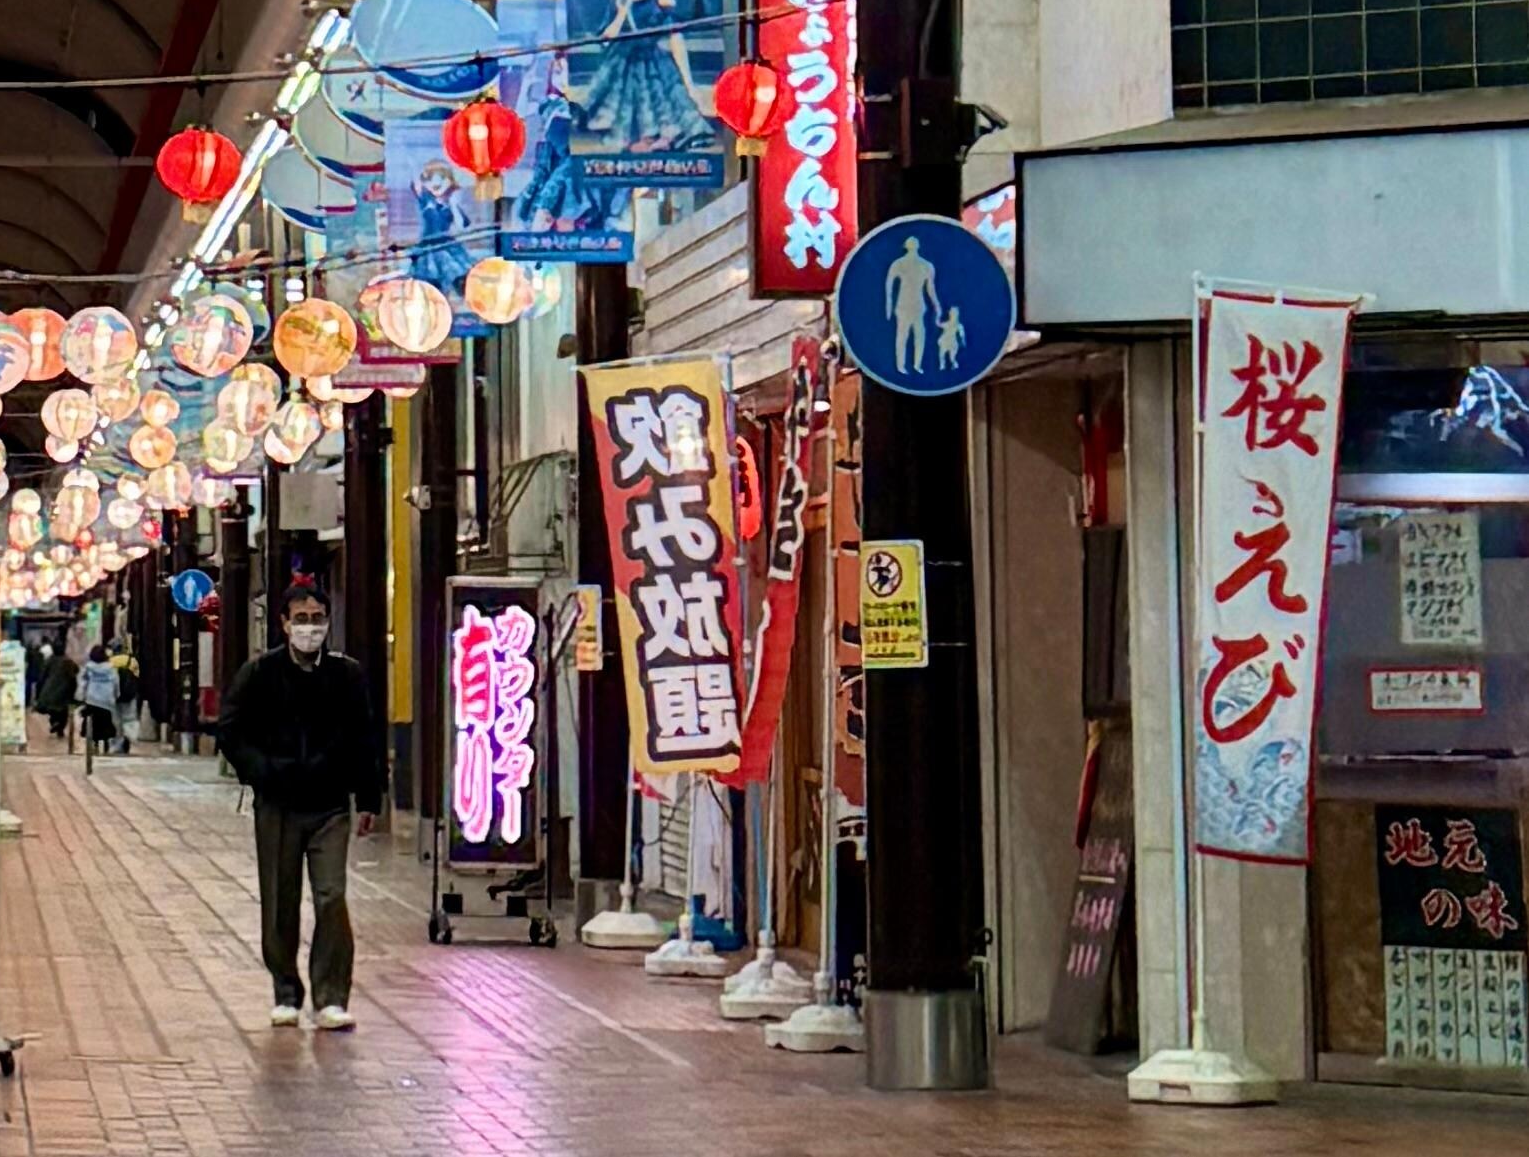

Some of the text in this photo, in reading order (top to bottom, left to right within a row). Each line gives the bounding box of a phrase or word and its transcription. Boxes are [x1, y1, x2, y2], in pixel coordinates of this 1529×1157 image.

[1203, 333, 1327, 744] 桜えび
[1384, 818, 1488, 874] 地元
[1421, 881, 1519, 939] の味
